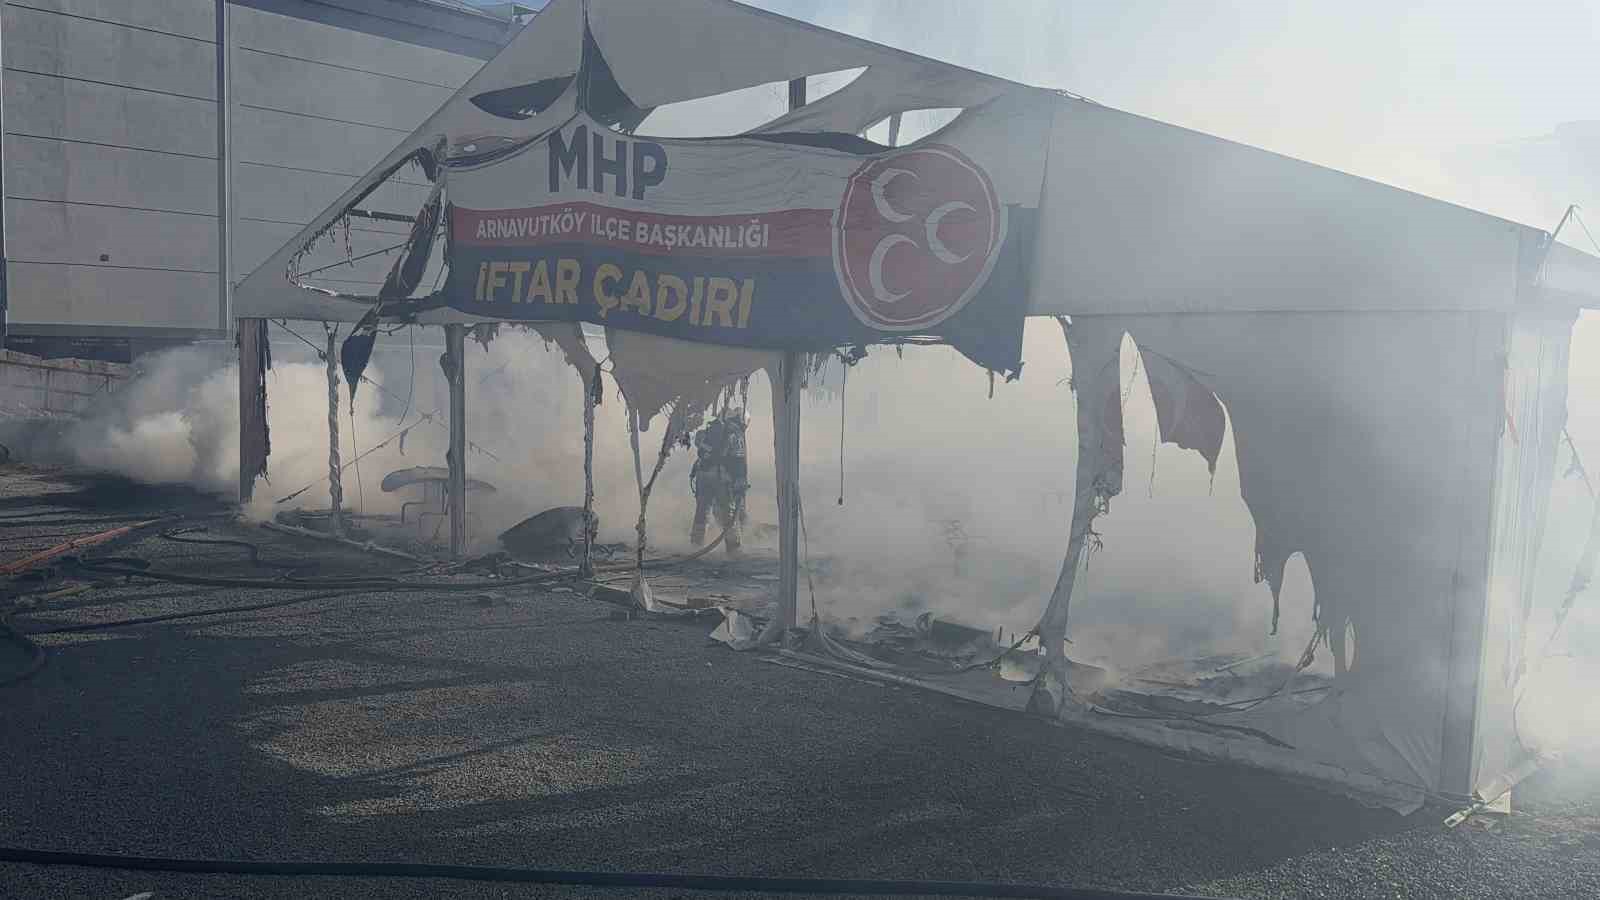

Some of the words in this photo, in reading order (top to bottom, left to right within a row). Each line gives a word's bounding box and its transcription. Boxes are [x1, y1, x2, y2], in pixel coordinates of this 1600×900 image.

[549, 124, 667, 200] MHP
[476, 208, 585, 239] ARNAVUTKÖY
[635, 218, 769, 251] BAŞKANLIĞI
[593, 263, 755, 328] ÇADIRI
